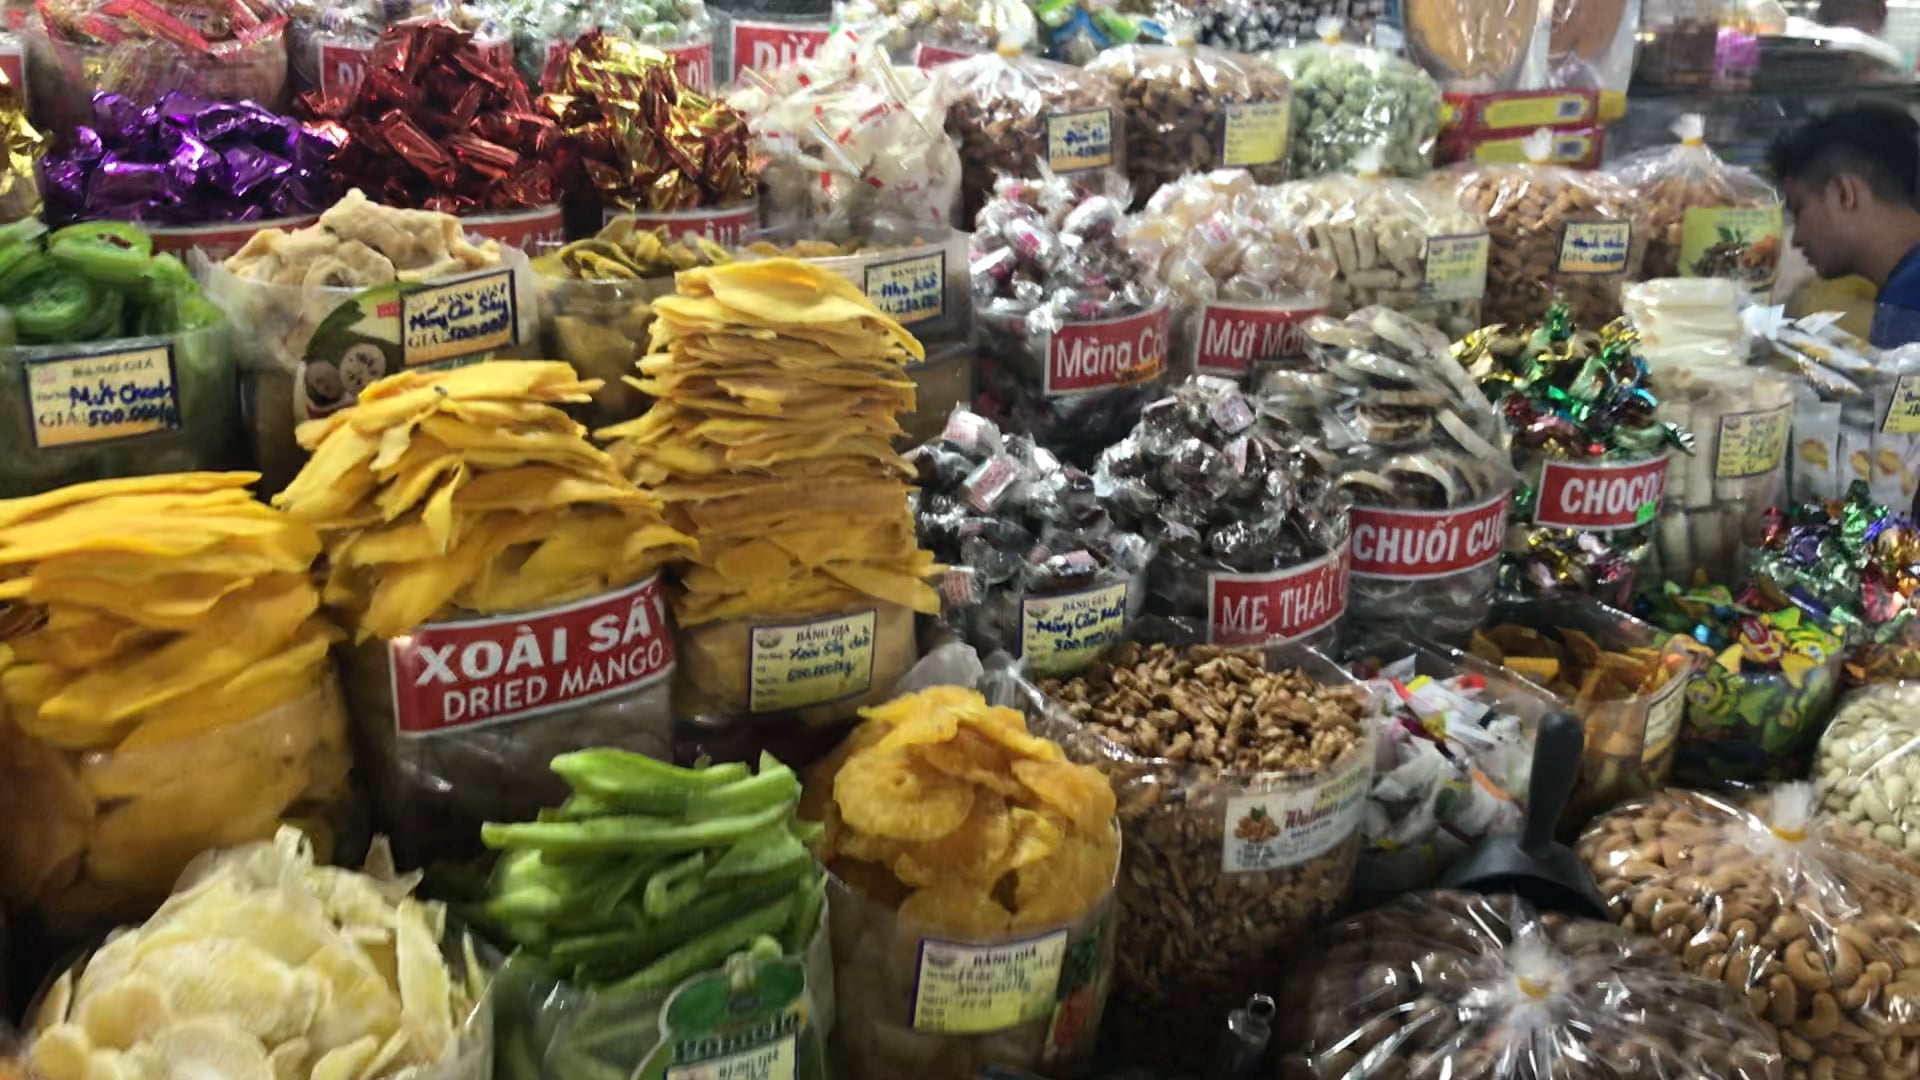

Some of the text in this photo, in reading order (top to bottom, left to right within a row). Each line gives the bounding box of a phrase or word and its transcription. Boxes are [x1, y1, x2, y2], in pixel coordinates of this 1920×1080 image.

[1352, 515, 1460, 565] CHUỐI
[1280, 567, 1335, 629] THÁI
[415, 624, 568, 687] XOÀI
[443, 638, 664, 723] DRIED MANGO
